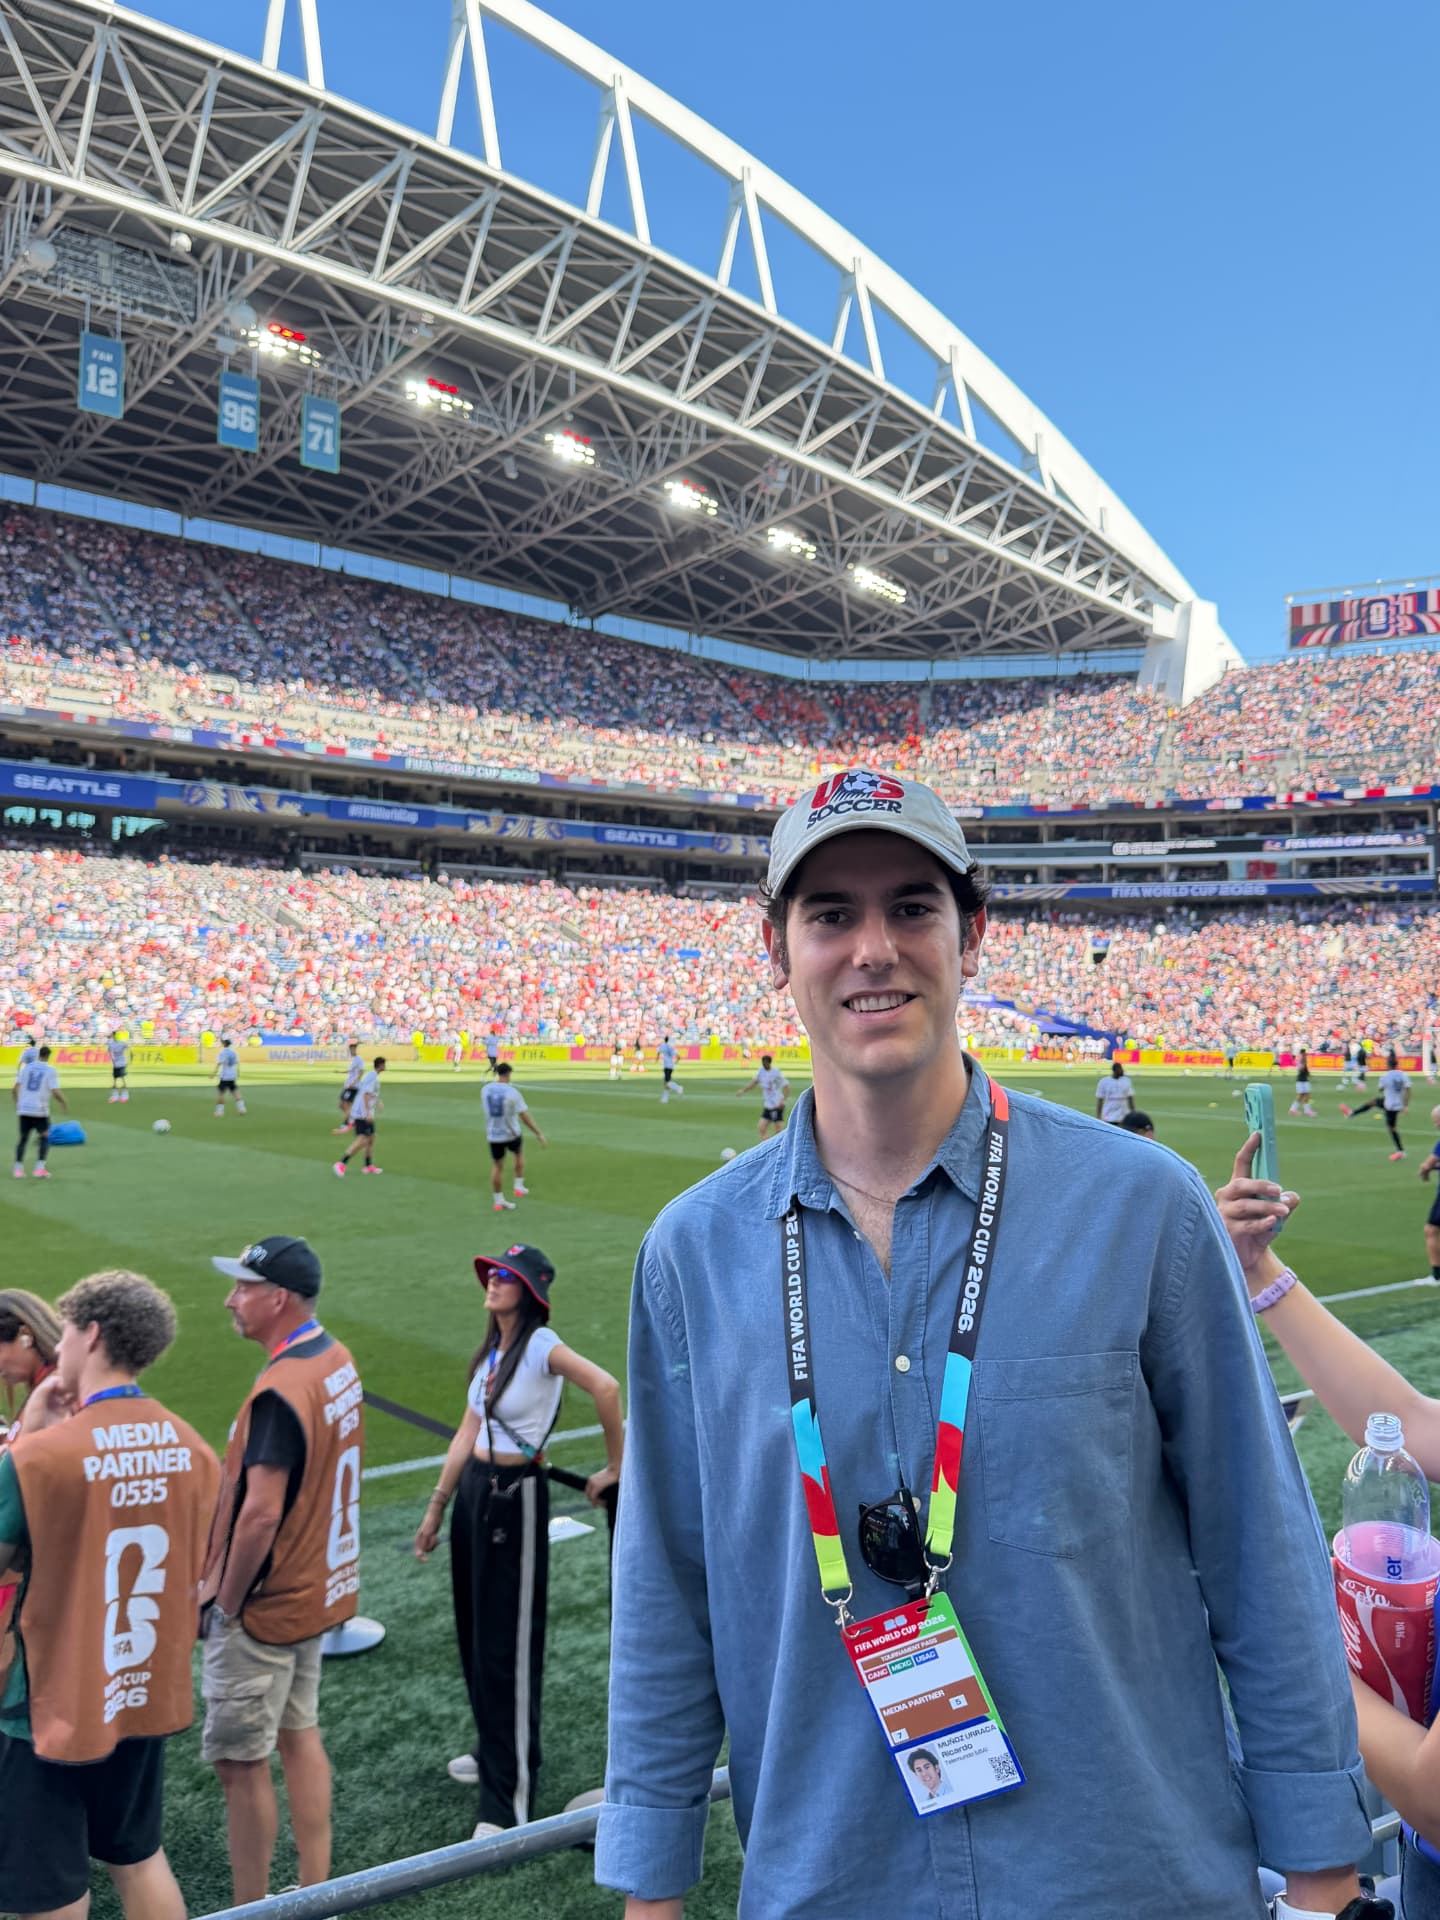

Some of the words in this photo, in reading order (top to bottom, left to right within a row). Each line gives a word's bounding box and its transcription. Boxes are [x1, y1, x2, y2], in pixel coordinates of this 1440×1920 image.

[84, 362, 119, 398] 12
[222, 400, 257, 433] 96
[307, 424, 335, 456] 71
[14, 773, 121, 798] SEATTLE
[806, 799, 902, 830] SOCCER
[604, 828, 679, 848] SEATTLE
[1140, 886, 1189, 897] WORLD
[268, 1049, 351, 1063] WASHINGTO
[988, 1131, 1003, 1163] FIFA
[979, 1166, 1001, 1226] WORLD
[785, 1207, 799, 1236] 20
[786, 1241, 800, 1271] CUP
[972, 1228, 991, 1265] CUP
[788, 1273, 804, 1339] WORLD
[957, 1265, 983, 1333] 2026
[792, 1339, 808, 1381] FIFA
[92, 1420, 180, 1451] MEDIA
[83, 1447, 192, 1482] PARTNER
[110, 1477, 168, 1508] 0535
[1387, 1556, 1402, 1579] er
[854, 1642, 872, 1654] FIFA
[873, 1631, 901, 1647] WORLD
[901, 1624, 917, 1637] CUP
[917, 1614, 947, 1629] 2026
[123, 1671, 152, 1687] CUP
[882, 1702, 908, 1717] MEDIA
[908, 1690, 945, 1708] PARTNER
[941, 1742, 974, 1758] Ricardo
